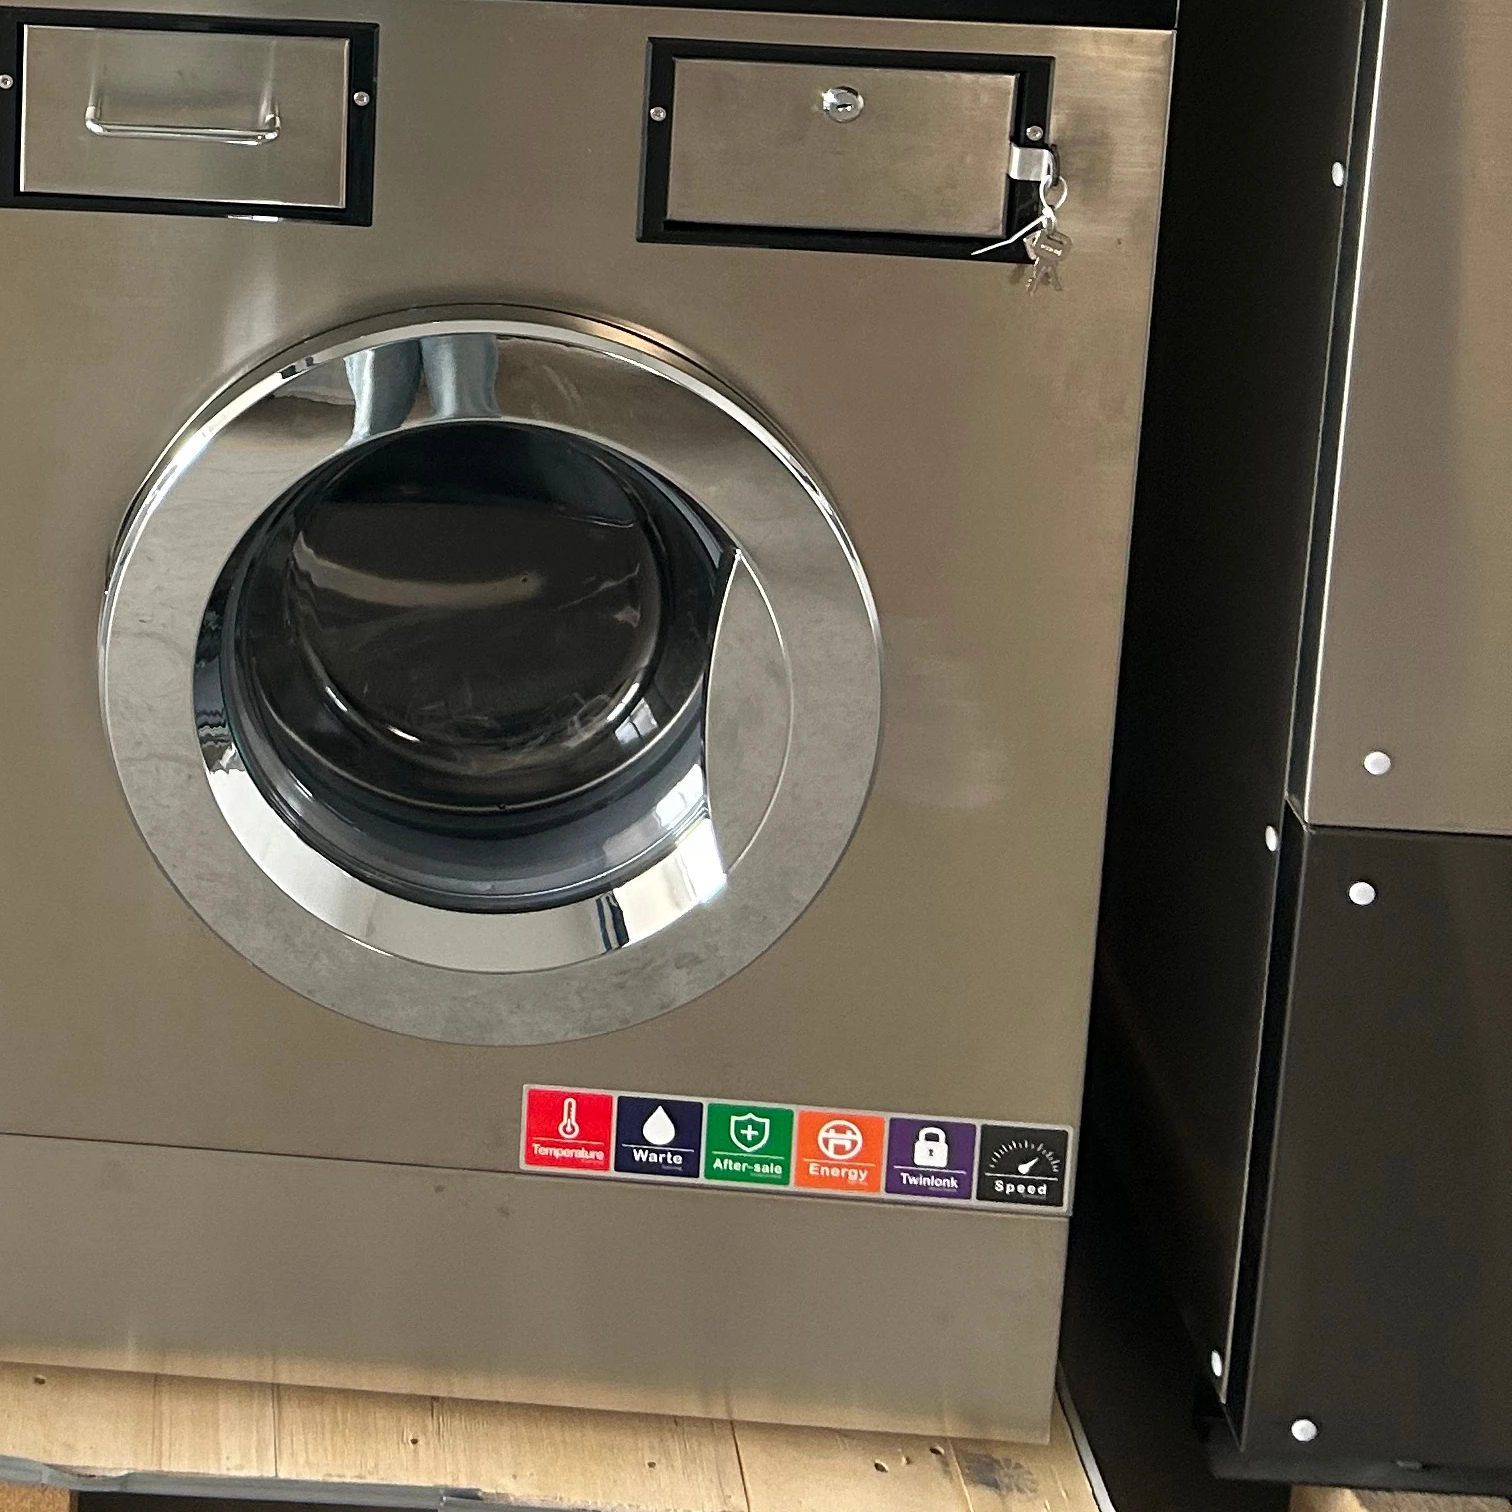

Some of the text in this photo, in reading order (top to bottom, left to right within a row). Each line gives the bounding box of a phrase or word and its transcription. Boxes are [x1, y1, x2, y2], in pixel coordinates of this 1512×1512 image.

[532, 1143, 605, 1162] Temperature
[713, 1158, 783, 1175] After-sale
[809, 1162, 868, 1182] Energy
[994, 1180, 1047, 1196] Speed
